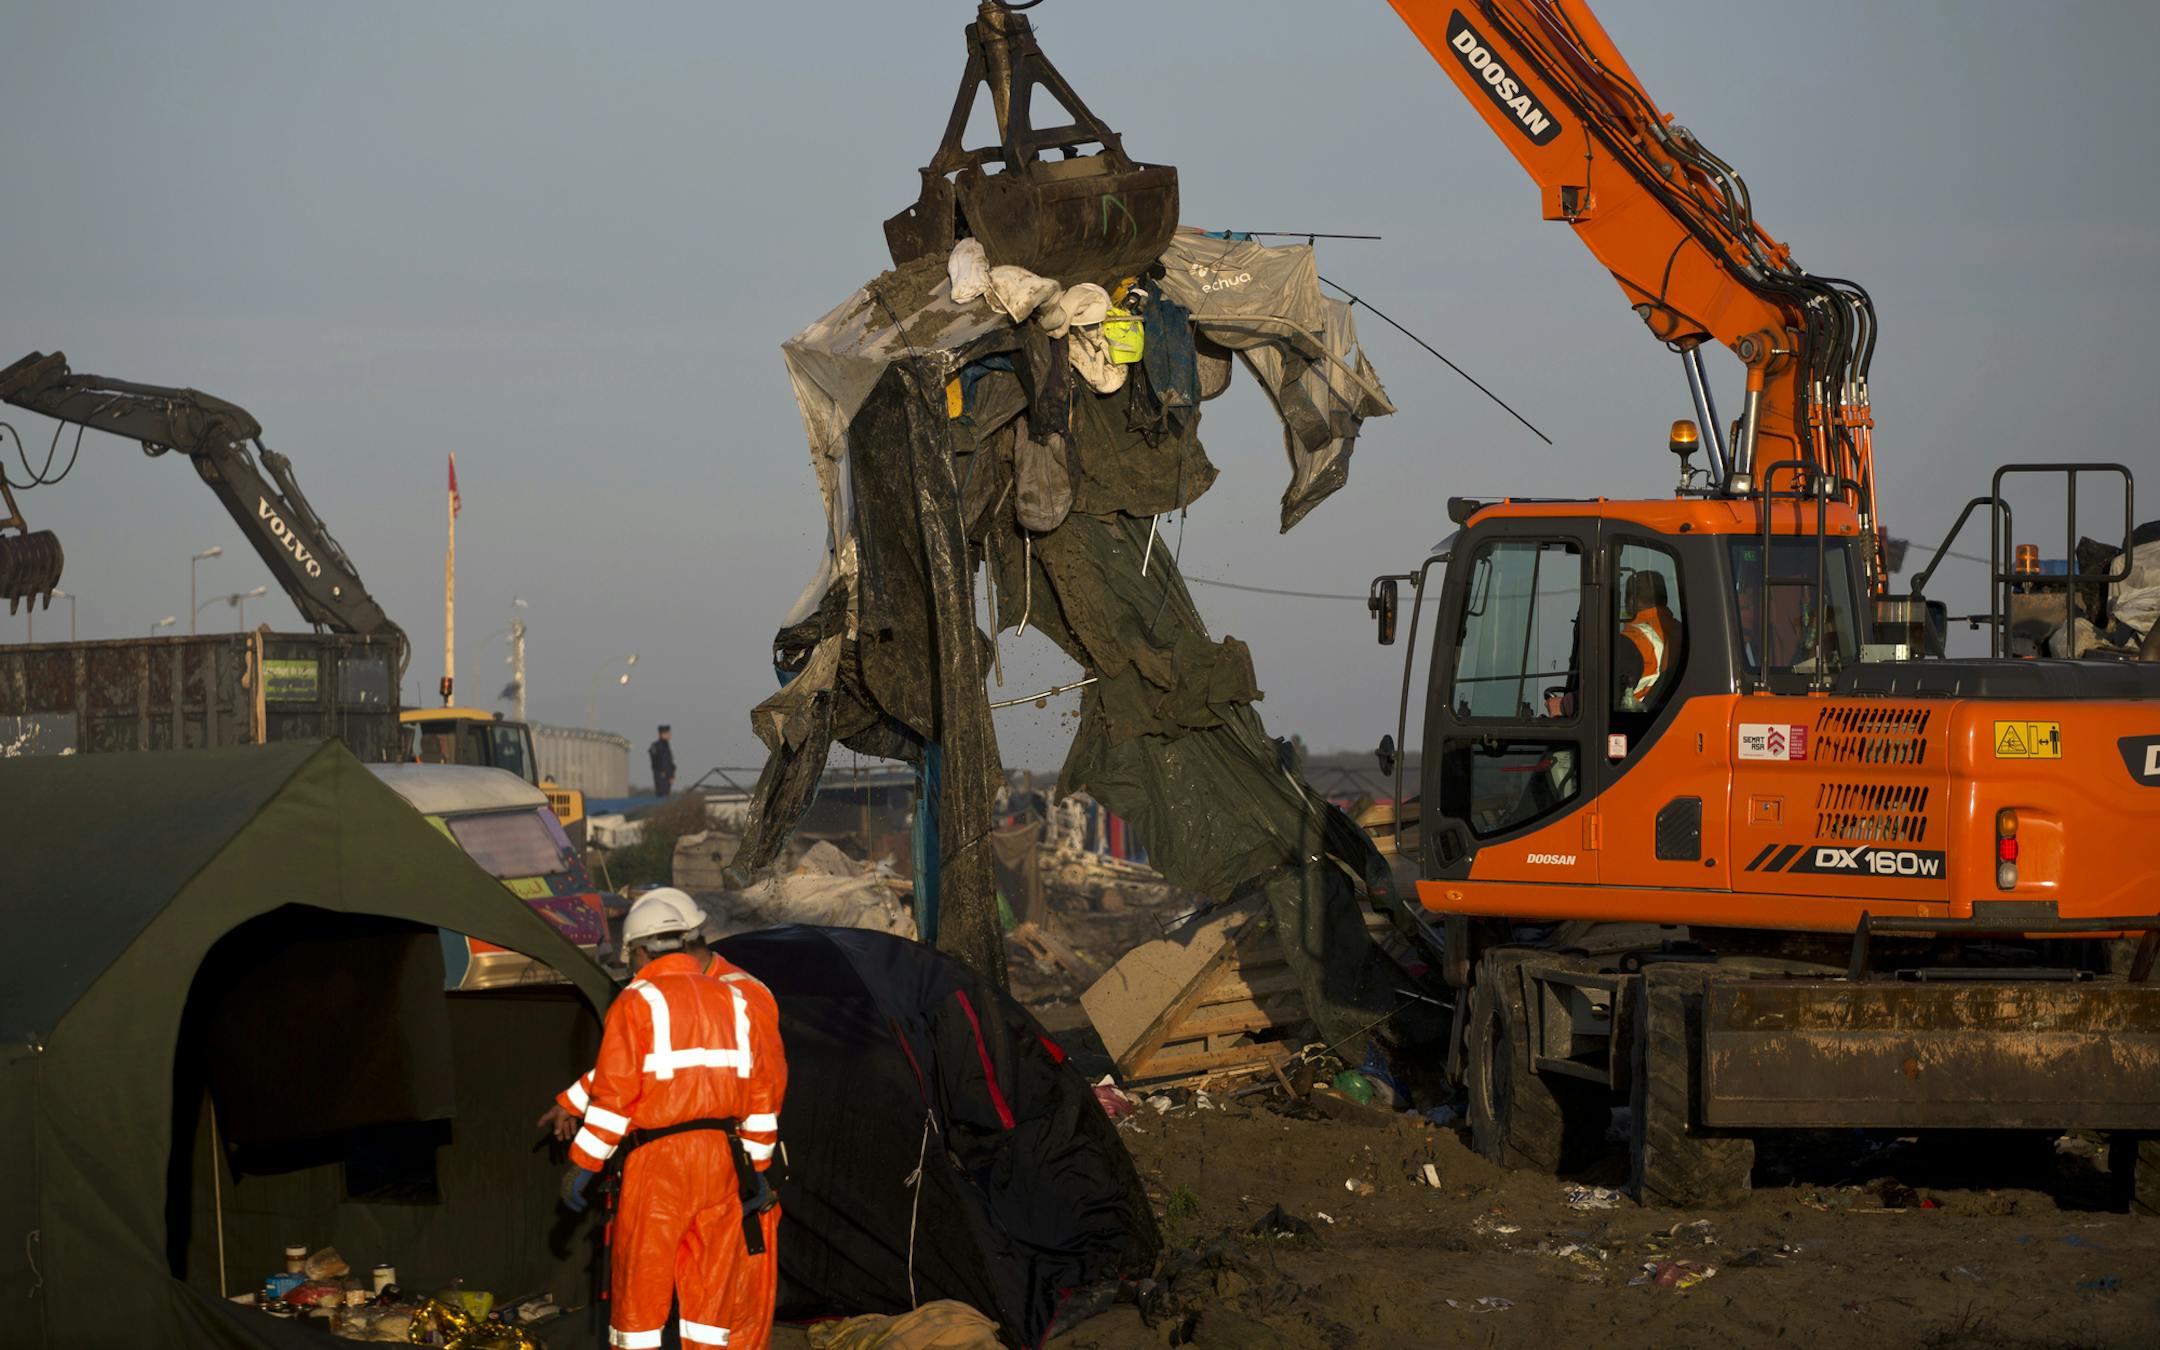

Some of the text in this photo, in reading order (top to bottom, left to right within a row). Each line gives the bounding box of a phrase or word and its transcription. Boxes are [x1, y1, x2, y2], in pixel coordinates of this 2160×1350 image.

[1452, 29, 1551, 136] DOOSAN
[1202, 273, 1252, 293] echua
[259, 495, 322, 578] VOLVO
[1527, 853, 1576, 865] DOOSAN
